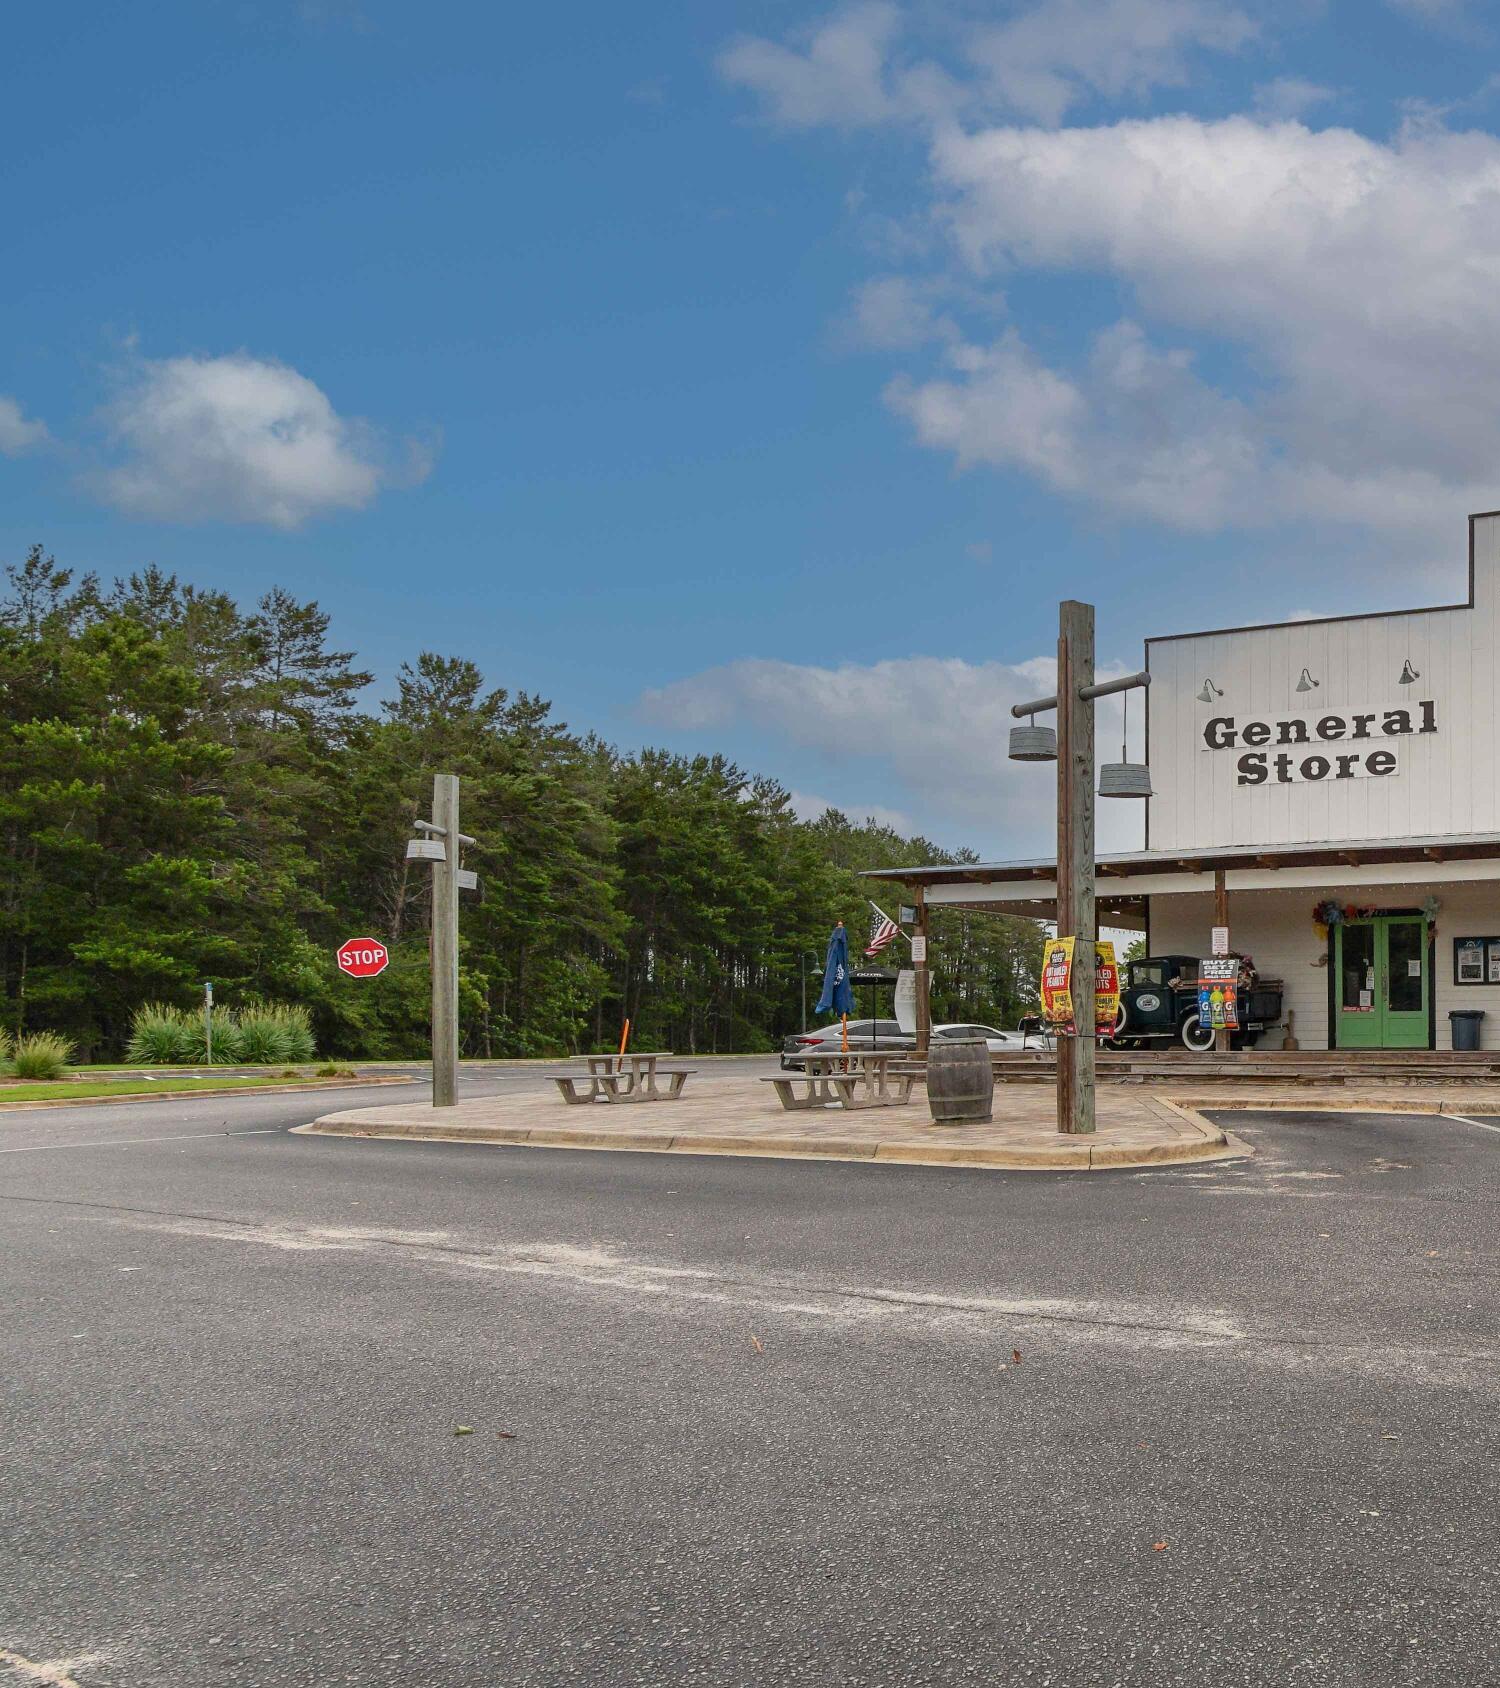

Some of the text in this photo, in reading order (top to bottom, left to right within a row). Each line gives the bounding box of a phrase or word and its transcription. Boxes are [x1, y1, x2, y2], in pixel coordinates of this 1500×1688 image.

[1203, 700, 1438, 749] General
[1237, 751, 1397, 785] Store
[342, 950, 384, 966] STOP
[1202, 1001, 1209, 1011] G
[1225, 1001, 1233, 1010] G
